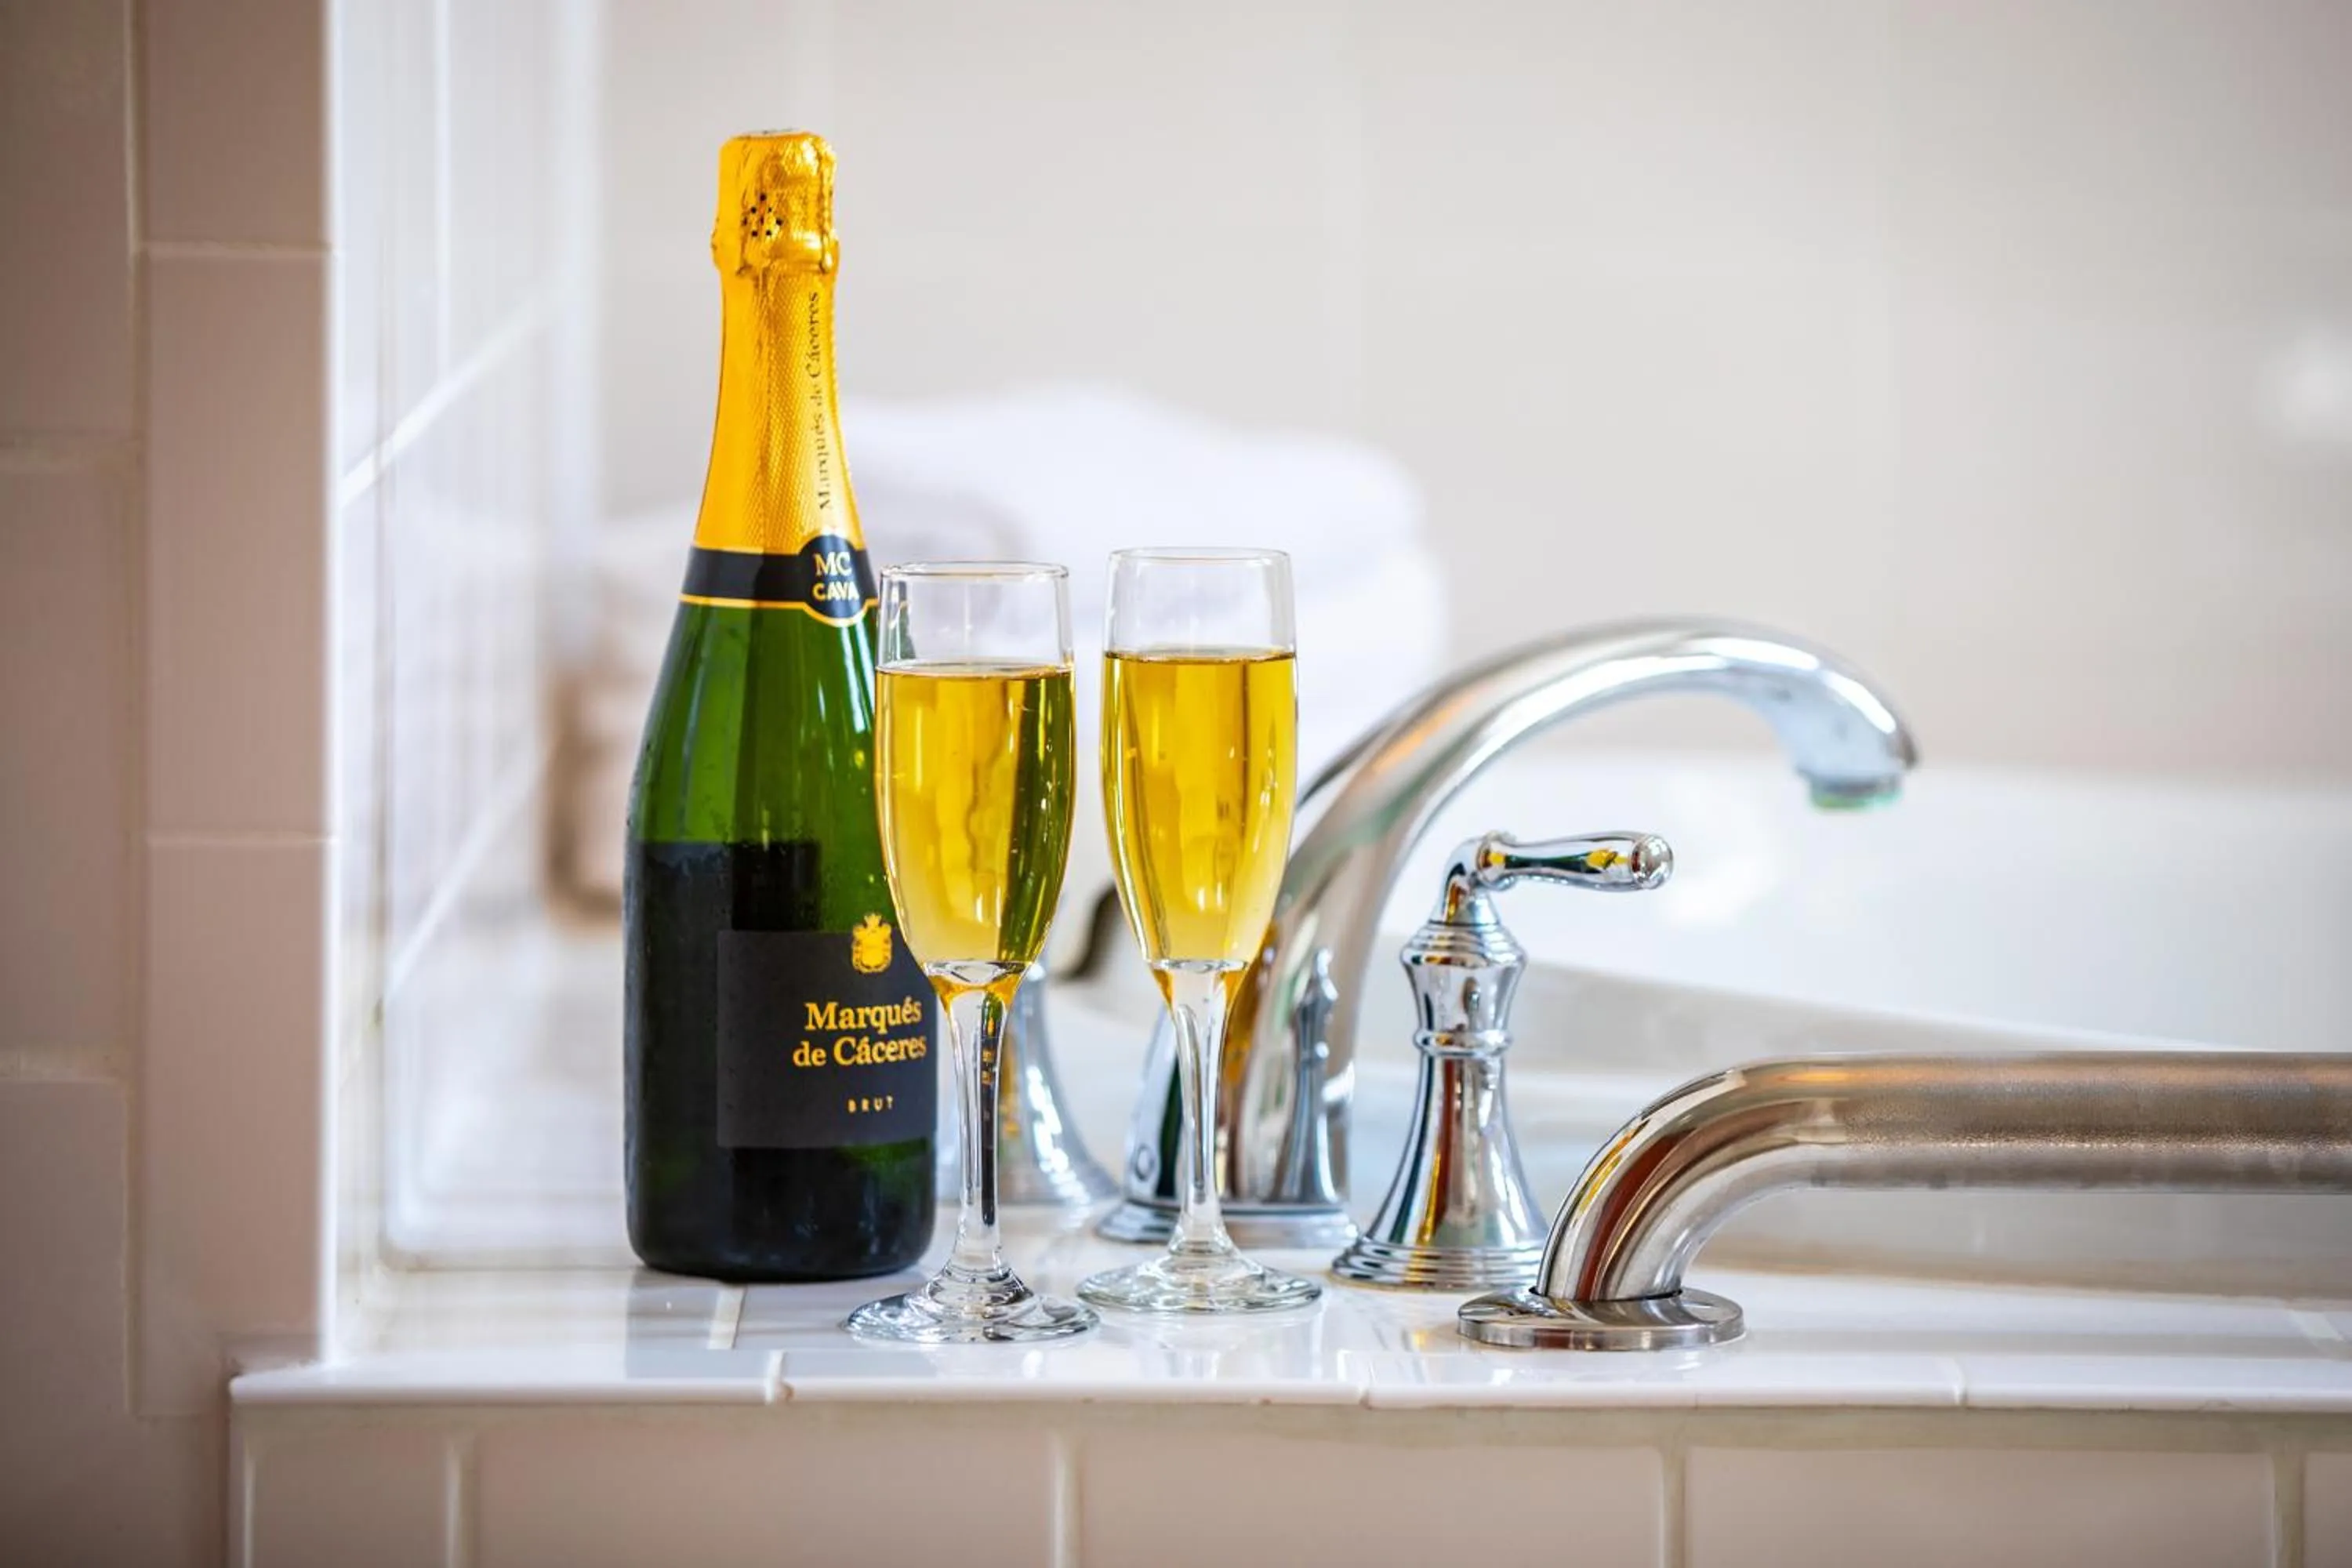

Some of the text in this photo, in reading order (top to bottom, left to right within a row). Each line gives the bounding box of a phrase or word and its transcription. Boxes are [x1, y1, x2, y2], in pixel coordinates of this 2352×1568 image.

[814, 551, 852, 577] MC
[812, 581, 860, 601] CAVA
[804, 996, 922, 1035] Marqués
[792, 1036, 927, 1067] de Cáceres
[848, 1095, 893, 1112] BRUT
